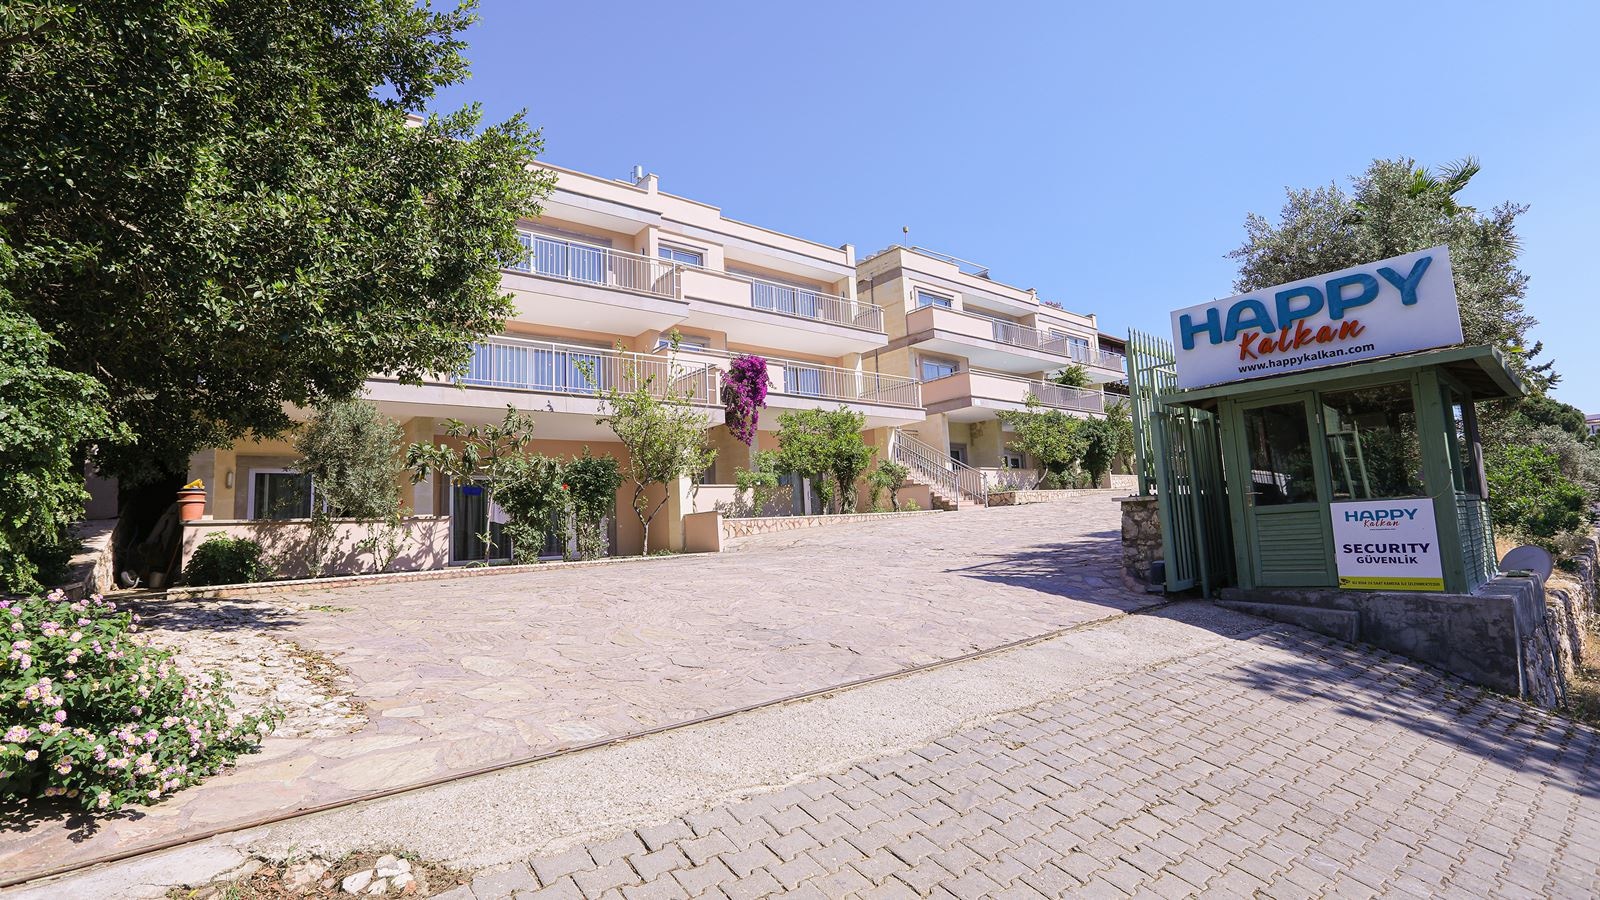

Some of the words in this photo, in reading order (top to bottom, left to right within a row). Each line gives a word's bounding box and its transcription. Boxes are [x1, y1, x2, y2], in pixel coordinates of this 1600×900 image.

[1179, 256, 1433, 350] HAPPY
[1239, 319, 1366, 361] Kalkan
[1238, 342, 1375, 373] www.happykalkan.com
[1345, 508, 1418, 522] HAPPY
[1363, 519, 1400, 528] Kalkan
[1343, 543, 1430, 553] SECURITY
[1356, 555, 1418, 564] GÜVENLİK
